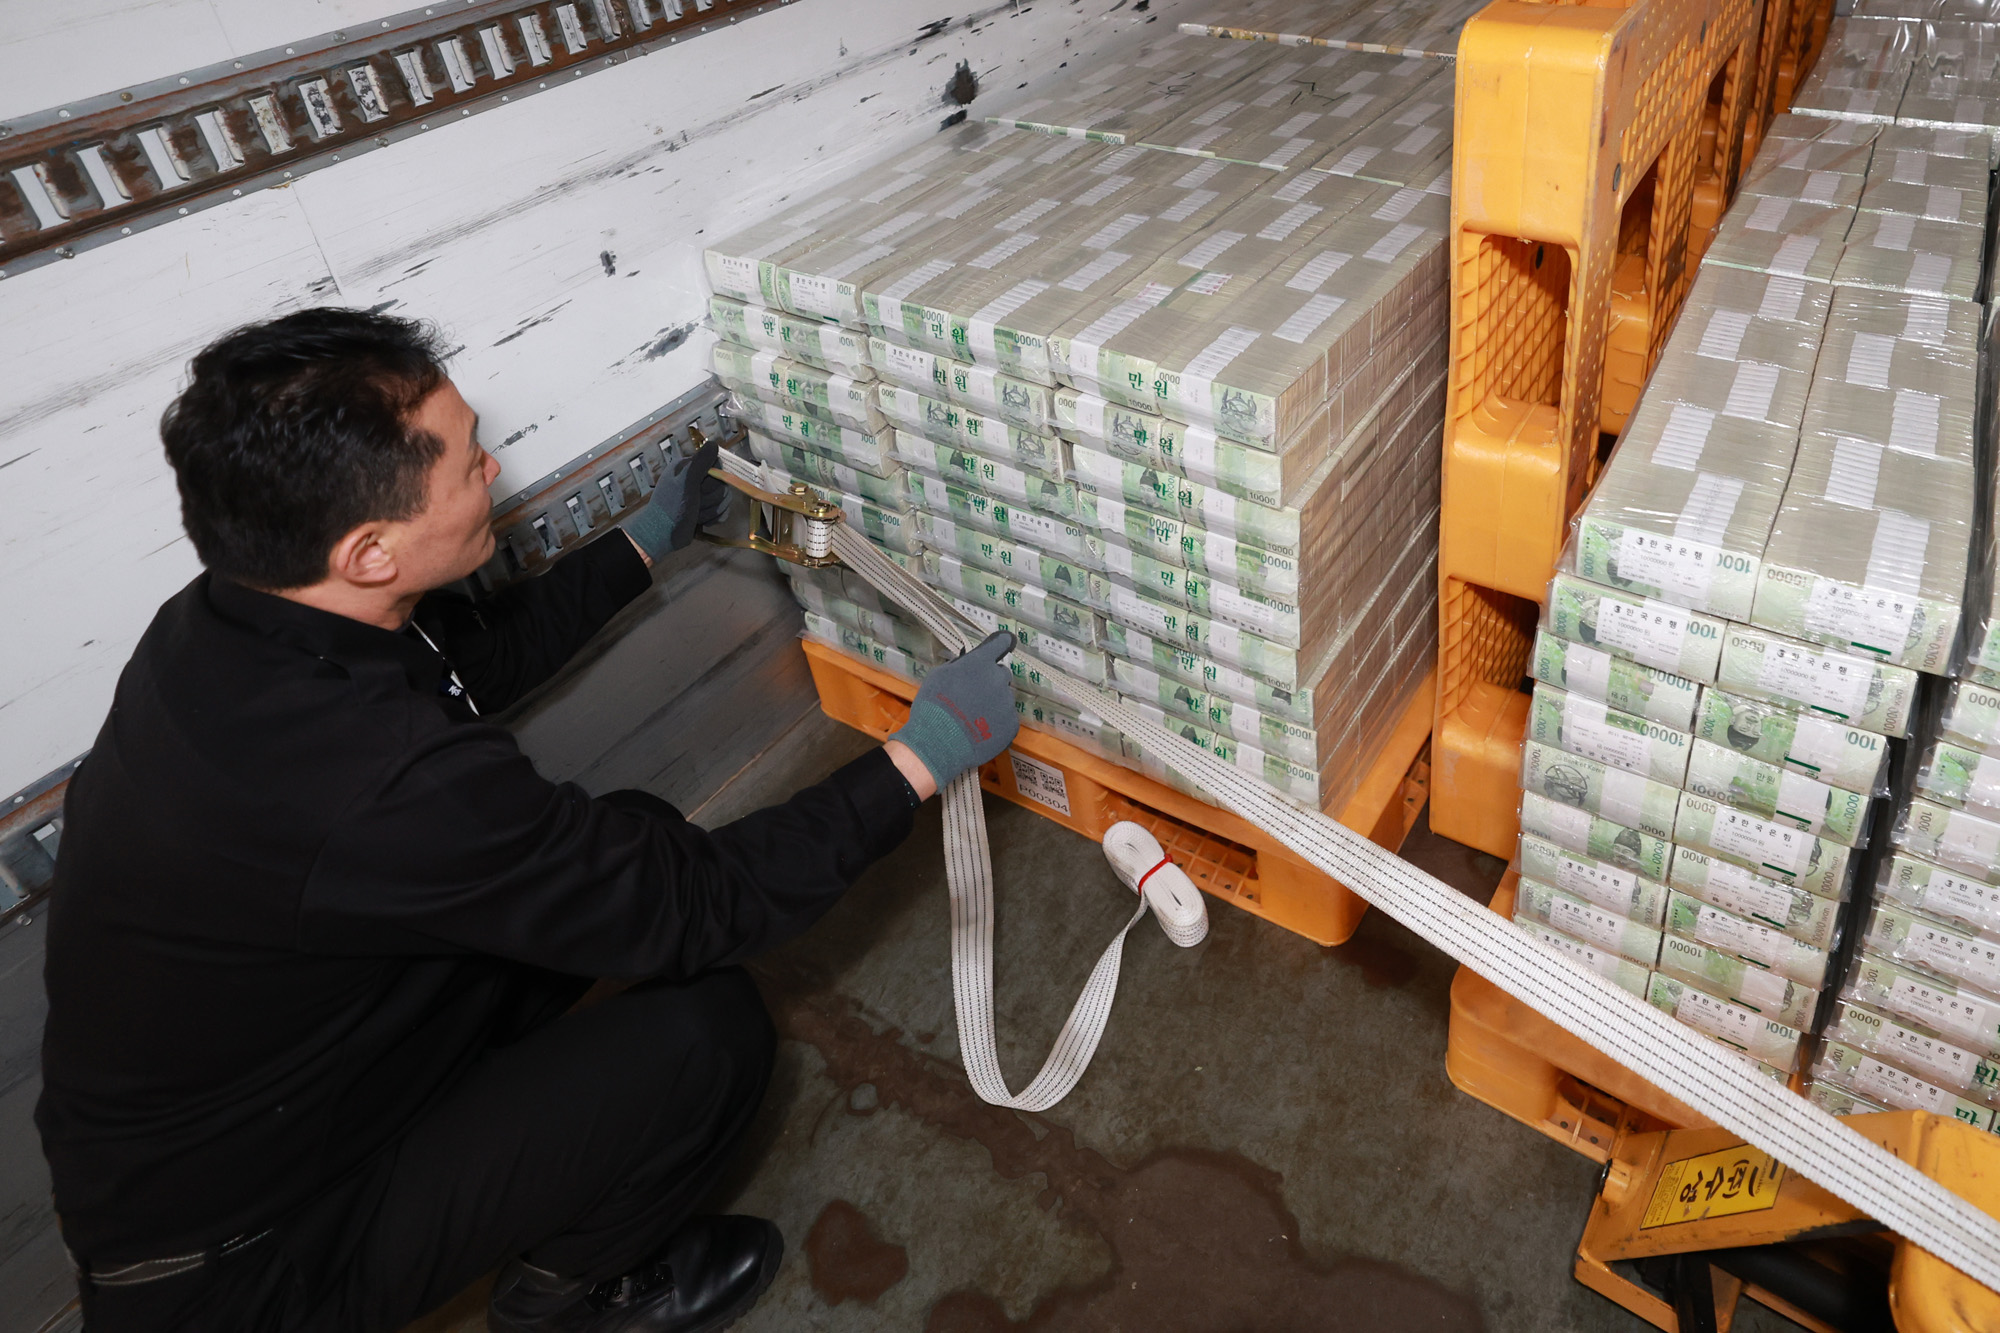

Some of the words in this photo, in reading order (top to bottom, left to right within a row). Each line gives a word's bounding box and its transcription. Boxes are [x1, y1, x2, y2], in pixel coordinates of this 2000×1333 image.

[839, 336, 855, 347] 100
[1014, 333, 1042, 349] 10000
[848, 390, 863, 399] 100
[1249, 491, 1276, 506] 10000
[1650, 539, 1703, 560] 한국은행
[1261, 553, 1293, 571] 10000
[1717, 553, 1752, 574] 100
[1626, 608, 1677, 629] 한국은행
[1791, 652, 1848, 676] 한국은행
[1647, 668, 1692, 692] 10000
[974, 716, 993, 741] 3M
[1282, 724, 1313, 741] 10000
[1640, 723, 1685, 748] 10000
[1845, 731, 1878, 751] 100
[1286, 764, 1315, 782] 10000
[1019, 784, 1069, 813] P00304
[1741, 819, 1792, 843] 한국은행
[1577, 865, 1620, 887] 한국은행
[1573, 907, 1616, 927] 한국은행
[1554, 938, 1594, 960] 한국은행
[1941, 937, 1995, 960] 한국은행
[1702, 997, 1747, 1022] 한국은행
[1921, 990, 1974, 1016] 한국은행
[1910, 1035, 1961, 1062] 한국은행
[1888, 1070, 1938, 1096] 한국은행
